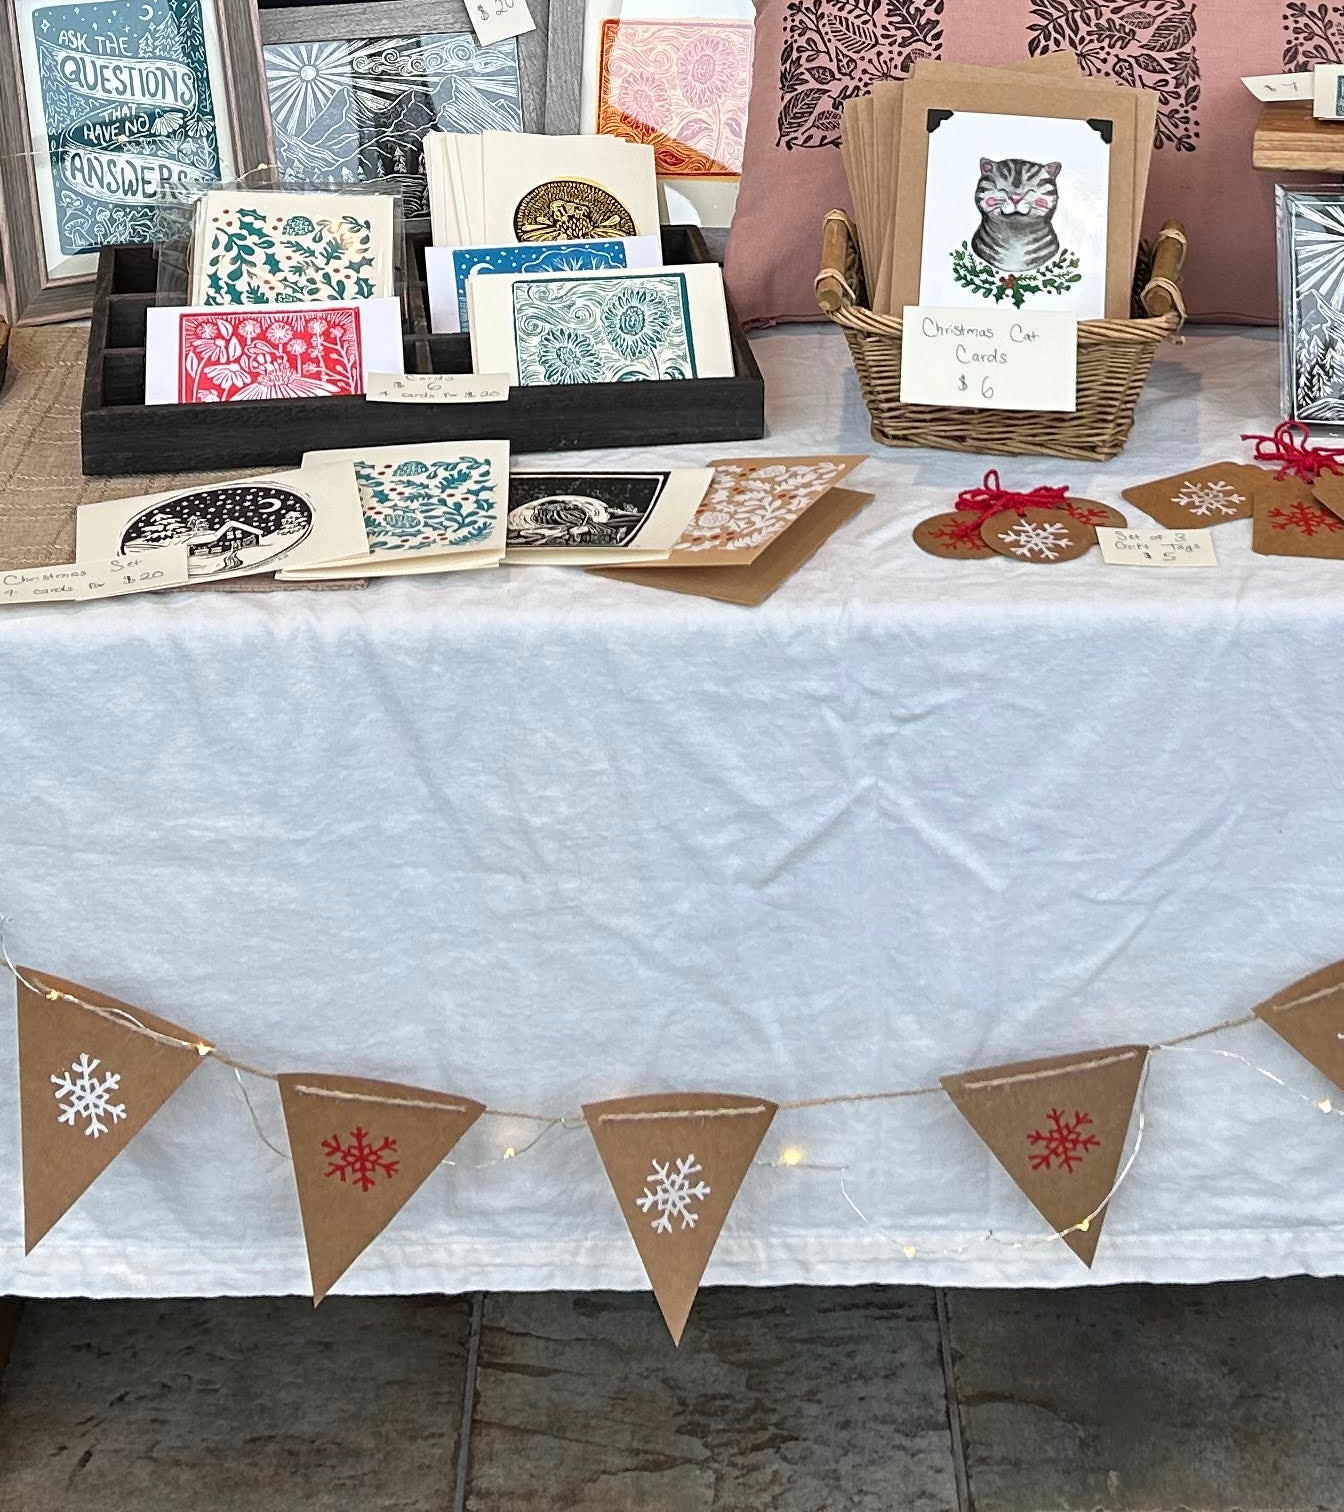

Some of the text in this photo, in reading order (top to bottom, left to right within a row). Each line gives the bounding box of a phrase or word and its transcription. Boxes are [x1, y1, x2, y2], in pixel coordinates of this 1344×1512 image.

[58, 30, 134, 56] ASK THE
[60, 55, 194, 106] QUESTIONS
[99, 103, 139, 122] THAT
[84, 114, 150, 147] HAVE NO
[70, 152, 190, 200] ANSWERS
[922, 317, 1040, 342] Christmas Cat
[956, 344, 1007, 364] Cards
[1115, 531, 1140, 541] Set
[3, 558, 144, 586] Christmas Set
[34, 586, 74, 595] cards
